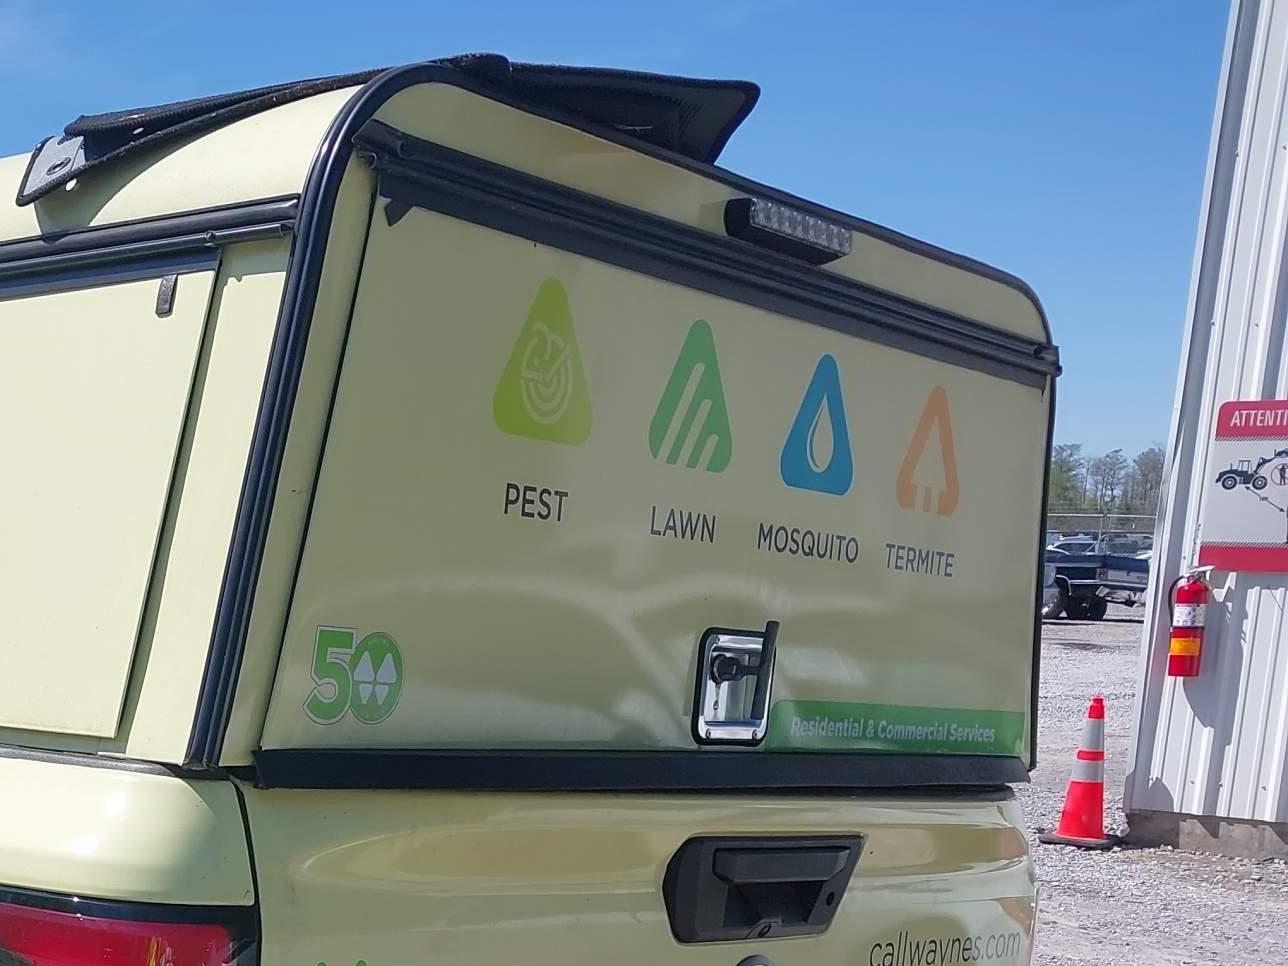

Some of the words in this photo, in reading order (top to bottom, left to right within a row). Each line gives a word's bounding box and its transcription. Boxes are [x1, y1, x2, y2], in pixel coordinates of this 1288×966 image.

[503, 482, 569, 522] PEST
[649, 505, 717, 544] LAWN
[757, 522, 860, 564] MOSQUITO
[885, 543, 955, 578] TERMITE
[791, 716, 864, 737] Residential
[865, 719, 875, 739] &
[878, 720, 947, 741] Commercial
[949, 723, 996, 743] Services
